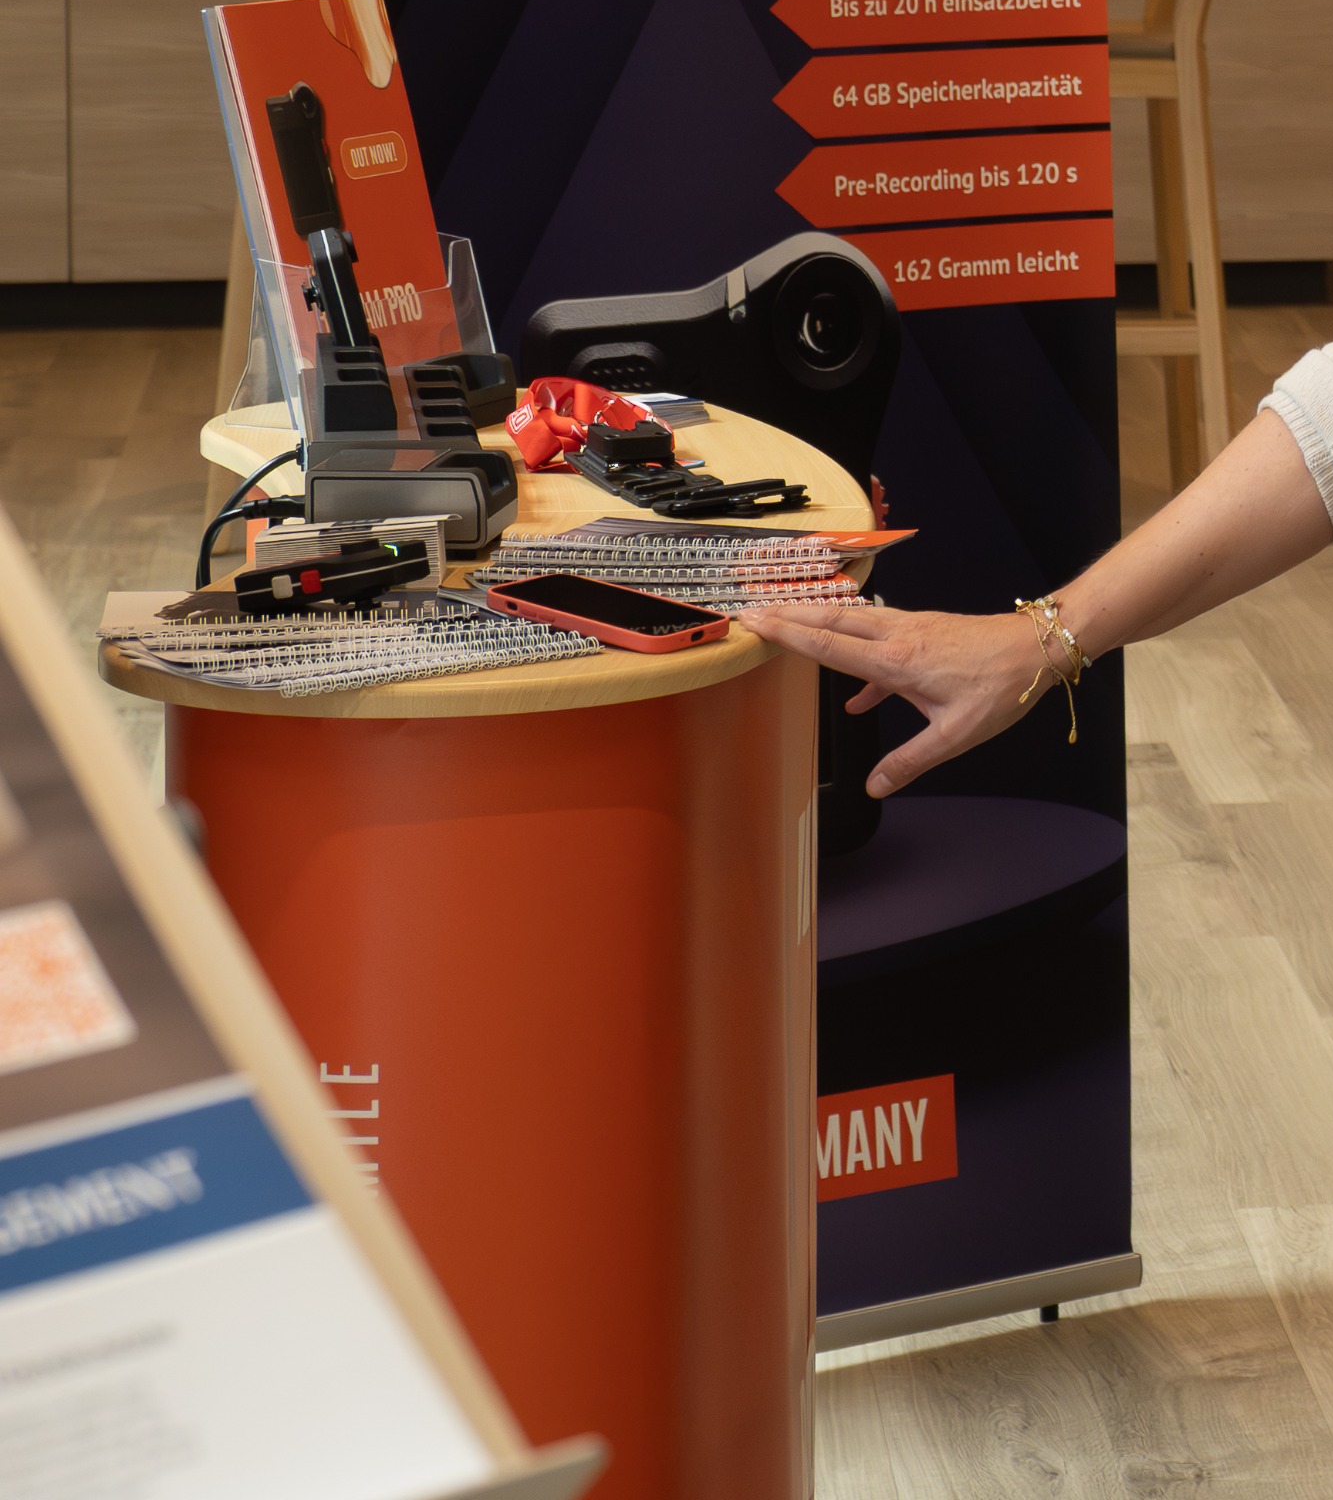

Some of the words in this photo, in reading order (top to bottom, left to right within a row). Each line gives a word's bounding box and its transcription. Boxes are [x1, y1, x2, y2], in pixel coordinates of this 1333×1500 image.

[832, 85, 859, 108] 64
[863, 83, 892, 106] GB
[896, 74, 1083, 109] Speicherkapazität
[350, 146, 370, 169] OUT
[370, 141, 398, 165] NOW!
[834, 168, 975, 197] Pre-Recording
[980, 165, 1010, 188] bis
[1017, 162, 1060, 186] 120
[1066, 166, 1078, 184] s
[894, 258, 932, 283] 162
[937, 256, 1011, 280] Gramm
[1017, 250, 1080, 274] leicht
[383, 281, 422, 326] PRO
[816, 1098, 928, 1180] MANY
